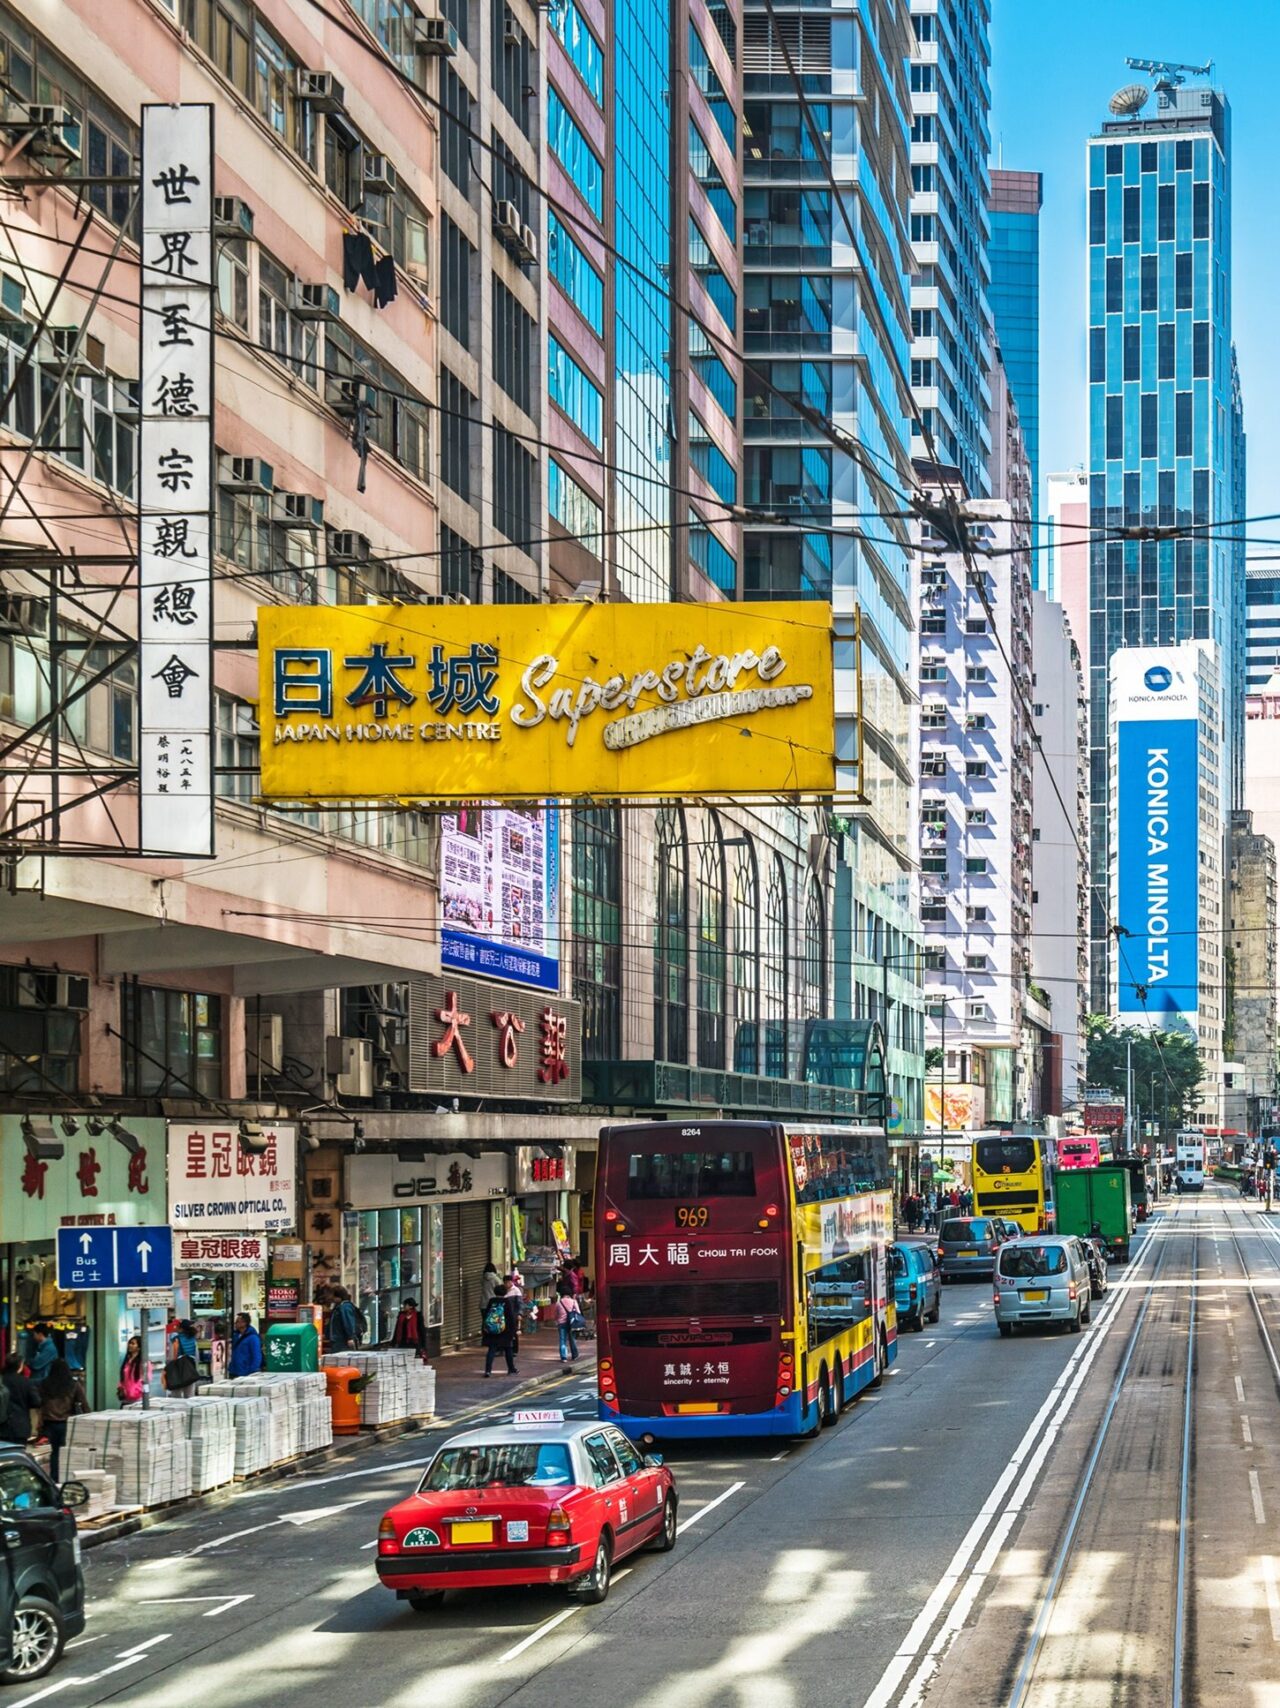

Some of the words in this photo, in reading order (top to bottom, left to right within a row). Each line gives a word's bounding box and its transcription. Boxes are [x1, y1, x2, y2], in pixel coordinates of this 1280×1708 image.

[151, 165, 201, 701] 世界至德宗親總會
[272, 642, 501, 720] 日本城
[511, 643, 788, 748] Superstore
[1128, 695, 1156, 703] KONICA
[1157, 694, 1189, 702] MINOLTA
[273, 723, 341, 744] JAPAN
[345, 723, 415, 743] HOME
[419, 721, 502, 741] CENTRE
[1147, 748, 1169, 857] KONICA
[1147, 864, 1169, 984] MINOLTA
[681, 1128, 701, 1136] 8264
[175, 1202, 206, 1218] SILVER
[207, 1201, 237, 1216] CROWN
[238, 1199, 270, 1214] OPTICAL
[677, 1207, 709, 1228] 969
[264, 1219, 279, 1228] SINCE
[180, 1239, 262, 1259] 皇冠眼鏡
[608, 1242, 690, 1267] 周大福
[698, 1249, 727, 1258] CHOW
[731, 1249, 747, 1257] TAI
[750, 1247, 779, 1256] FOOK
[76, 1256, 97, 1266] Bus
[72, 1269, 102, 1282] 巴士
[663, 1378, 693, 1386] sincerity
[703, 1376, 730, 1385] eternity
[517, 1411, 543, 1422] TAXI
[418, 1534, 425, 1542] 5
